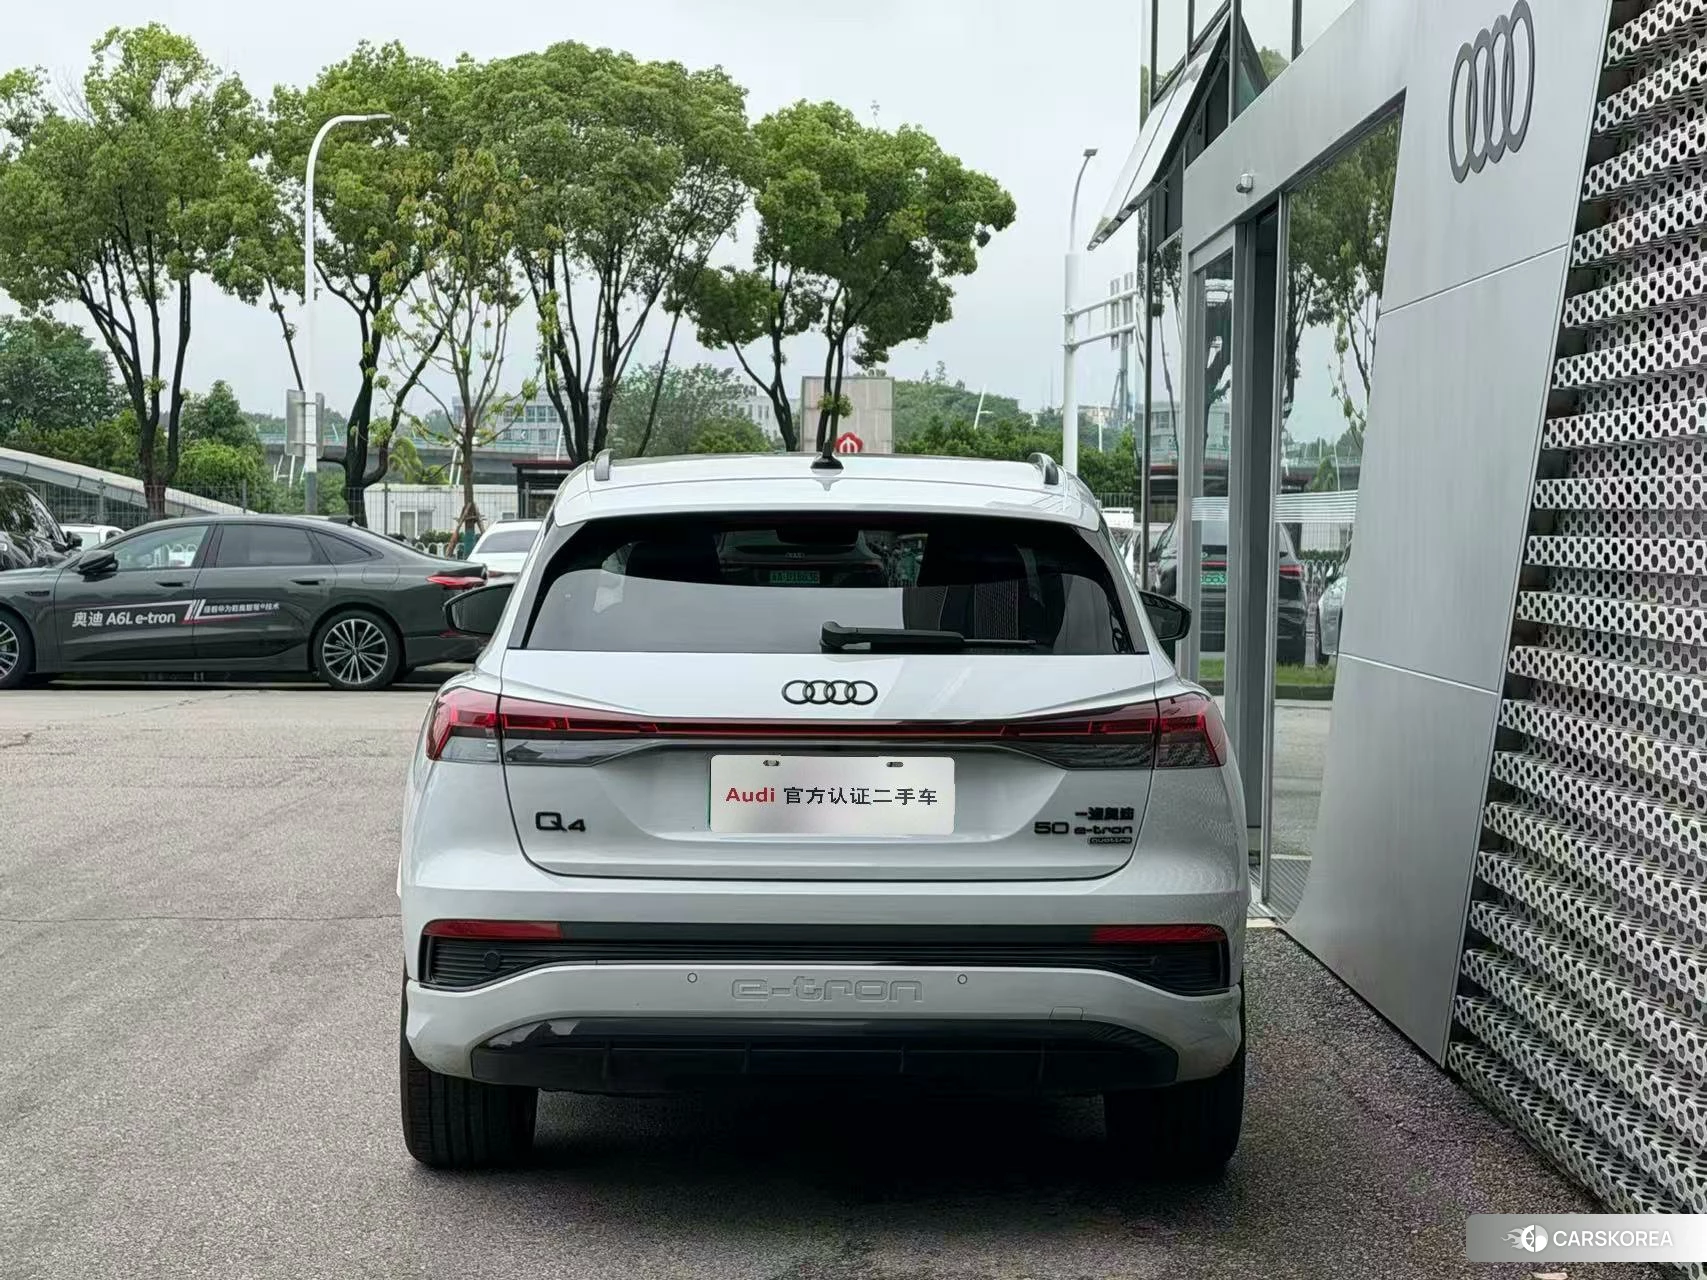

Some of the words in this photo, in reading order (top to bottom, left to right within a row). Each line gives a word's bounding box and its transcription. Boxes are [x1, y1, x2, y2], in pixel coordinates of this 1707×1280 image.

[72, 611, 103, 627] 奥迪
[105, 612, 133, 625] A6L
[135, 612, 176, 625] e-tron
[725, 787, 775, 803] Audi
[783, 787, 938, 806] 官方认证二手车
[535, 812, 586, 832] Q4
[1034, 821, 1070, 835] 50
[1074, 825, 1133, 835] e-tron
[732, 976, 922, 1001] e-tron
